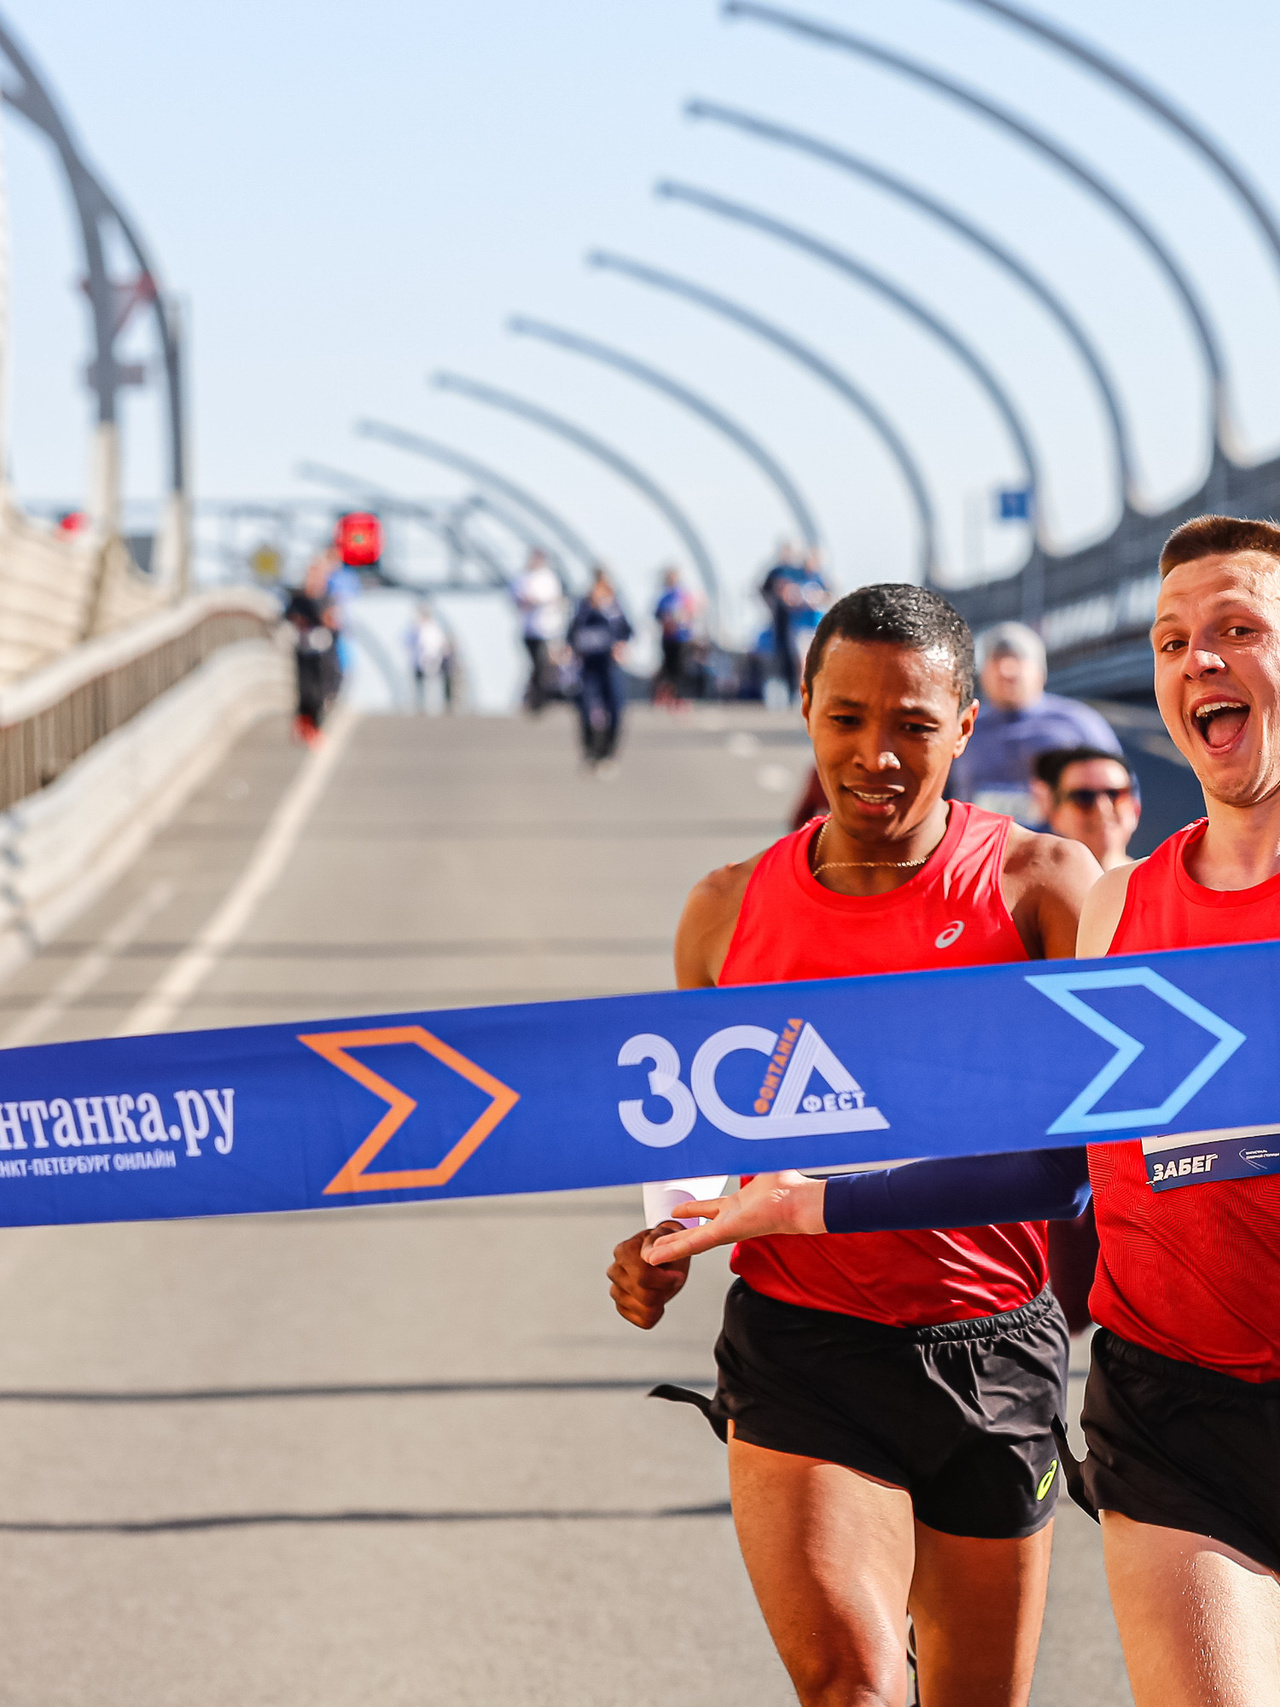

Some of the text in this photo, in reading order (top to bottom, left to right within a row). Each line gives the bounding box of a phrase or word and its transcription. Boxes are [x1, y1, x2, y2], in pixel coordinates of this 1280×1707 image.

[753, 1018, 804, 1115] ФОНТАНКА
[802, 1092, 866, 1113] ФЕСТ
[113, 1148, 176, 1172] ОНЛАЙН
[1153, 1153, 1218, 1182] ЗАБЕГ
